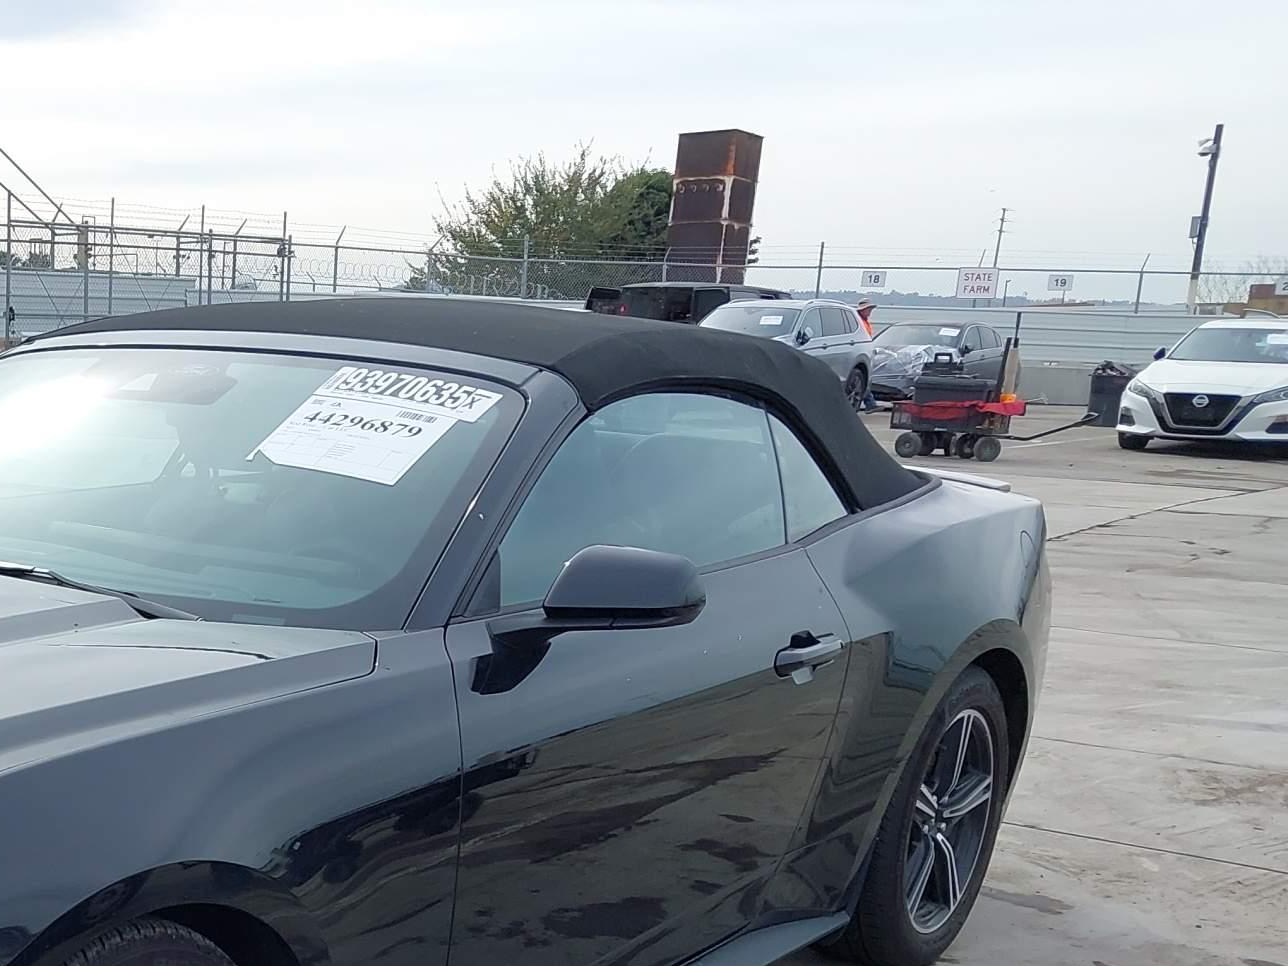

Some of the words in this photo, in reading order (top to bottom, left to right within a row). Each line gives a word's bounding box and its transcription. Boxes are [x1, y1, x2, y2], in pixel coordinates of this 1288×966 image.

[867, 274, 880, 284] 18
[963, 272, 993, 282] STATE
[1054, 278, 1067, 287] 19
[963, 285, 990, 294] FARM
[304, 410, 423, 438] 44296879
